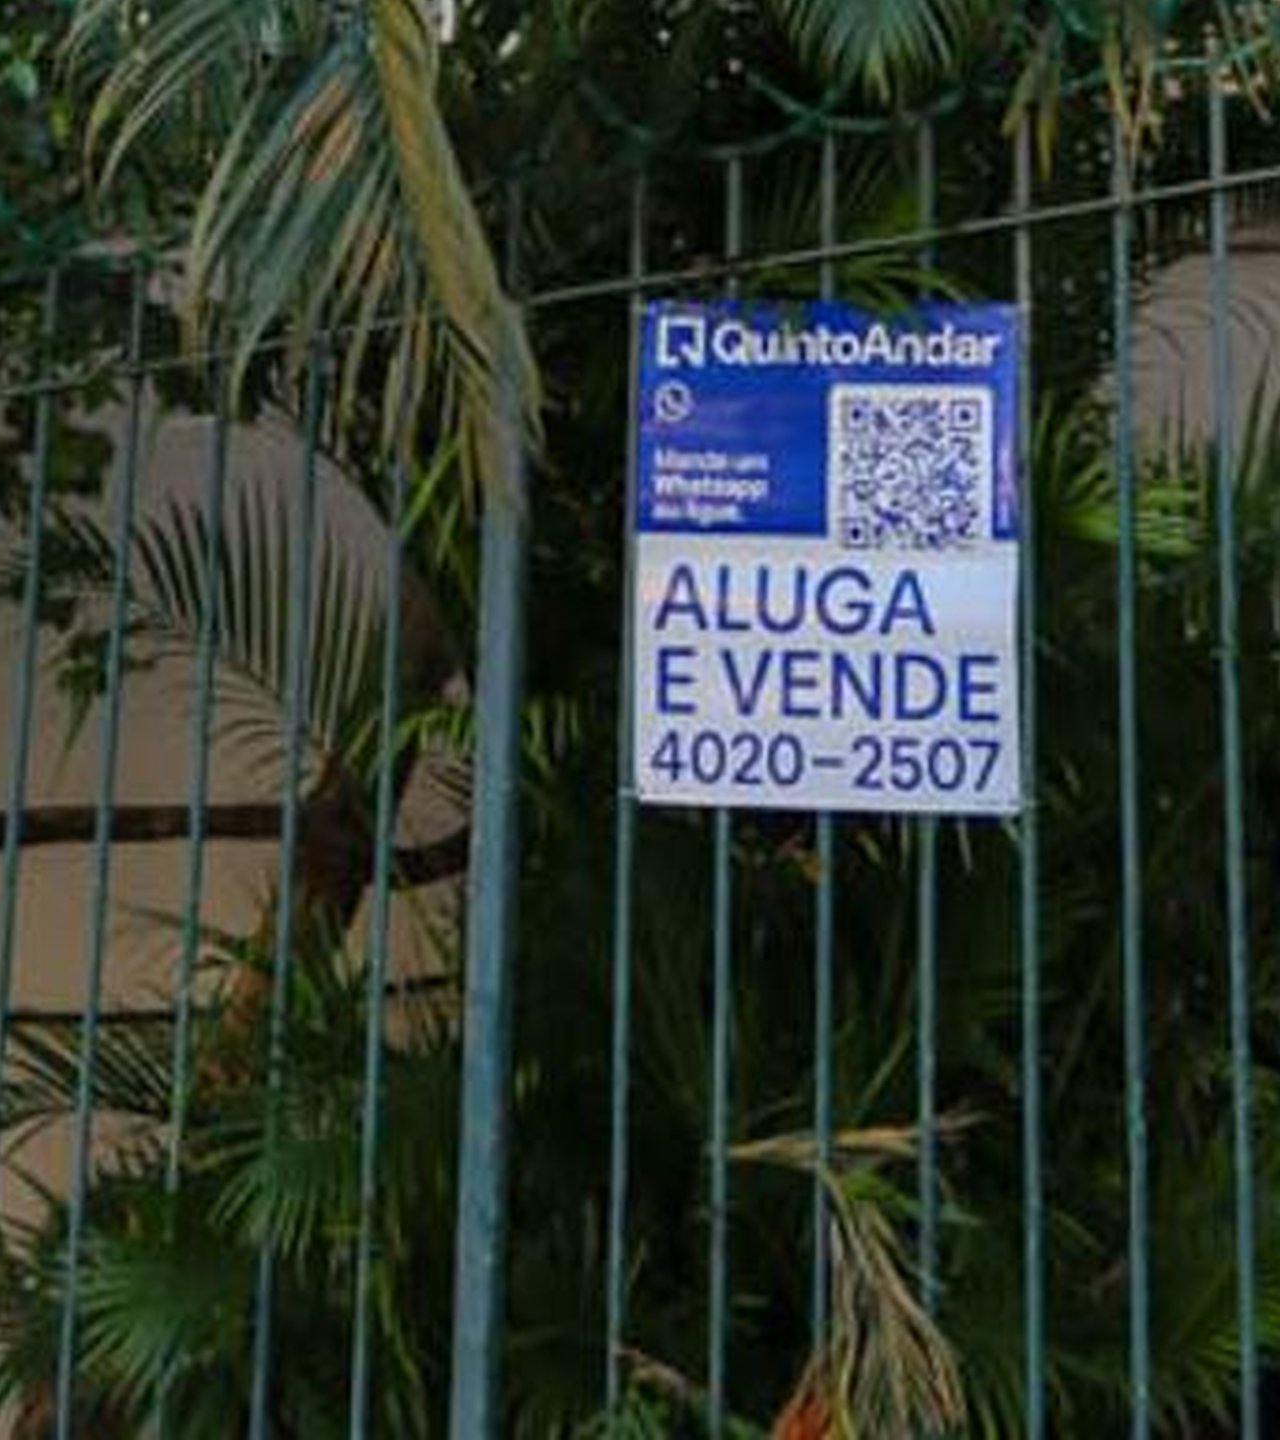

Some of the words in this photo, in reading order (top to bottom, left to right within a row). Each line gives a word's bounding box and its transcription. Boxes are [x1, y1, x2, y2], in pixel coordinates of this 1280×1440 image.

[712, 322, 1000, 367] QuintoAndar
[654, 563, 936, 636] ALUGA
[654, 646, 699, 715] E
[722, 649, 1001, 723] VENDE
[650, 729, 1003, 792] 4020-2507
